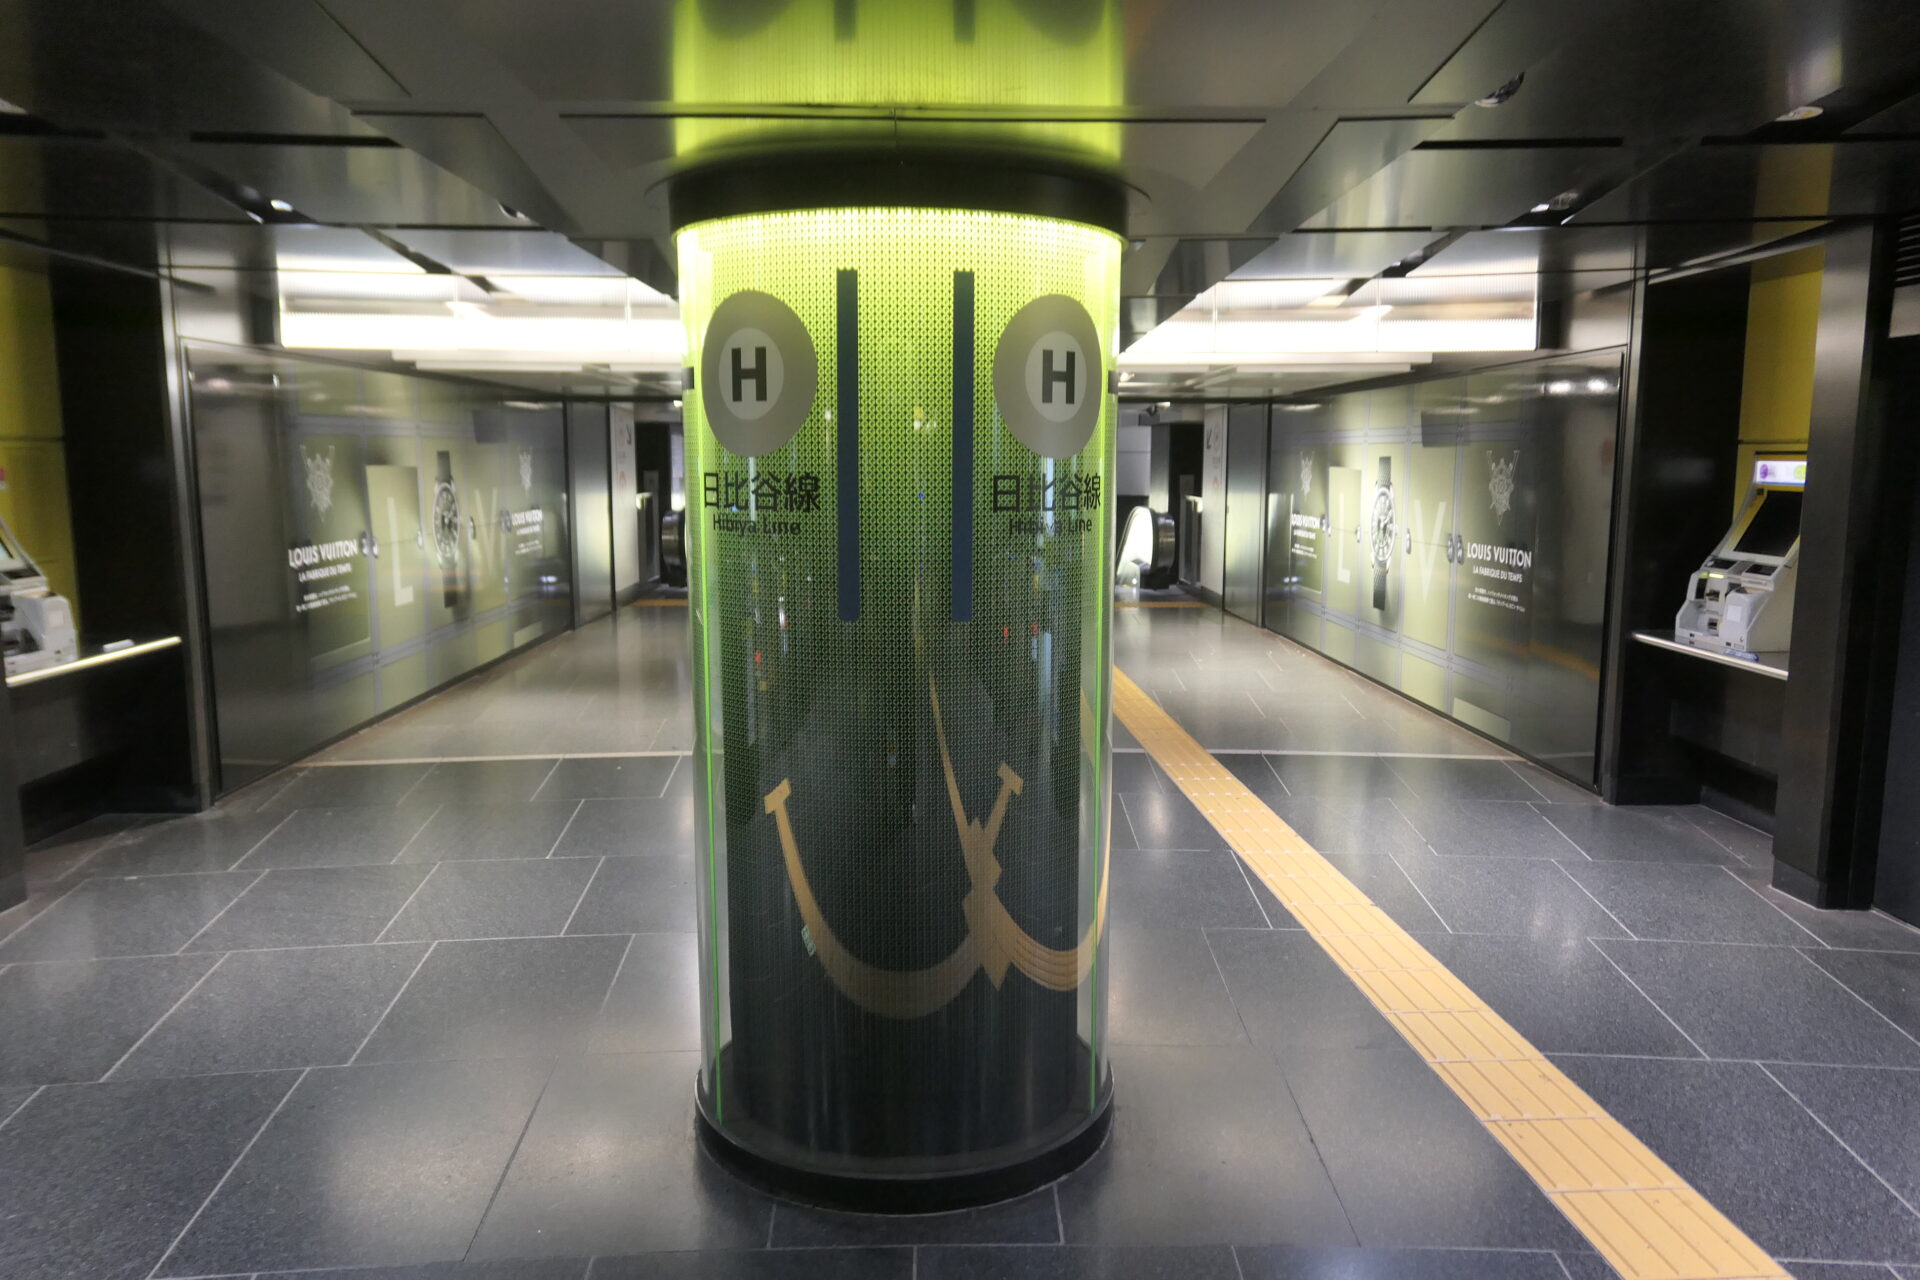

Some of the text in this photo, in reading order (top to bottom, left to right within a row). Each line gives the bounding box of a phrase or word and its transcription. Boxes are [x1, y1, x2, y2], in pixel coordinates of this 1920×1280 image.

[731, 346, 768, 402] H
[1042, 349, 1076, 405] H
[703, 471, 821, 513] 日比谷線
[992, 473, 1101, 513] 日比谷線
[713, 513, 801, 538] Hibiya Line
[1067, 516, 1093, 534] Line
[288, 539, 358, 569] LOUIS VUITTON
[1467, 542, 1532, 568] LOUIS VUITTON
[1473, 565, 1479, 574] LA
[1500, 570, 1508, 580] DU
